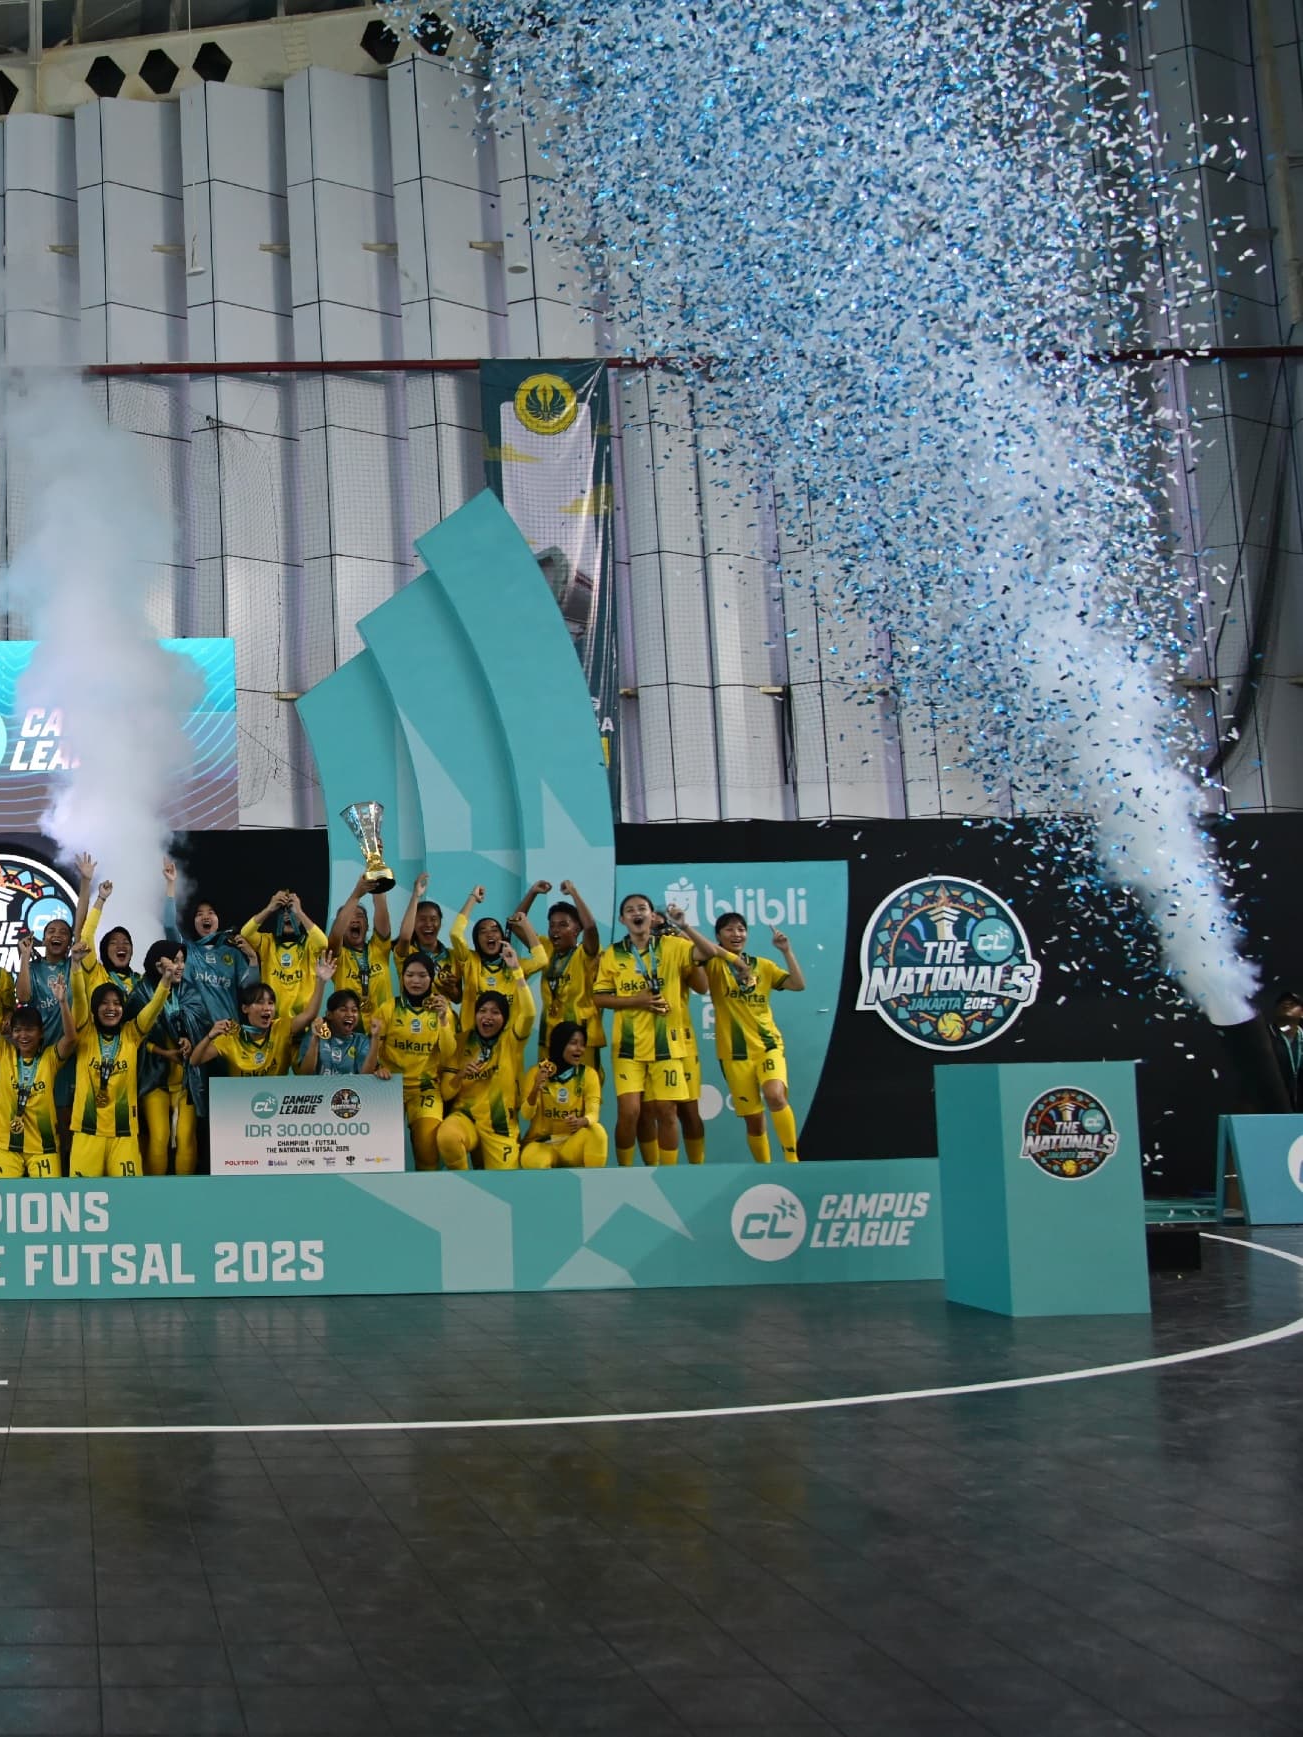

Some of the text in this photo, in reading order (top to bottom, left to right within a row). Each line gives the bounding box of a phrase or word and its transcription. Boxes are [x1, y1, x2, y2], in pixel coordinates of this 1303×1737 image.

[9, 740, 81, 771] LEA
[923, 941, 969, 964] THE
[865, 964, 1035, 1004] NATIONALS
[908, 997, 996, 1010] JAKARTA 2025
[394, 1039, 433, 1052] Jakart
[762, 1058, 775, 1073] 18
[663, 1070, 677, 1087] 10
[282, 1094, 324, 1104] CAMPUS
[419, 1095, 435, 1108] 15
[279, 1104, 317, 1115] LEAGUE
[245, 1122, 370, 1138] IDR 30.000.000
[1055, 1121, 1081, 1134] THE
[1022, 1134, 1116, 1156] NATIONALS
[37, 1158, 51, 1178] 14
[119, 1160, 137, 1177] 19
[740, 1191, 931, 1239] CL CAMPUS
[809, 1220, 915, 1249] LEAGUE
[24, 1242, 196, 1286] FUTSAL
[214, 1240, 325, 1283] 2025
